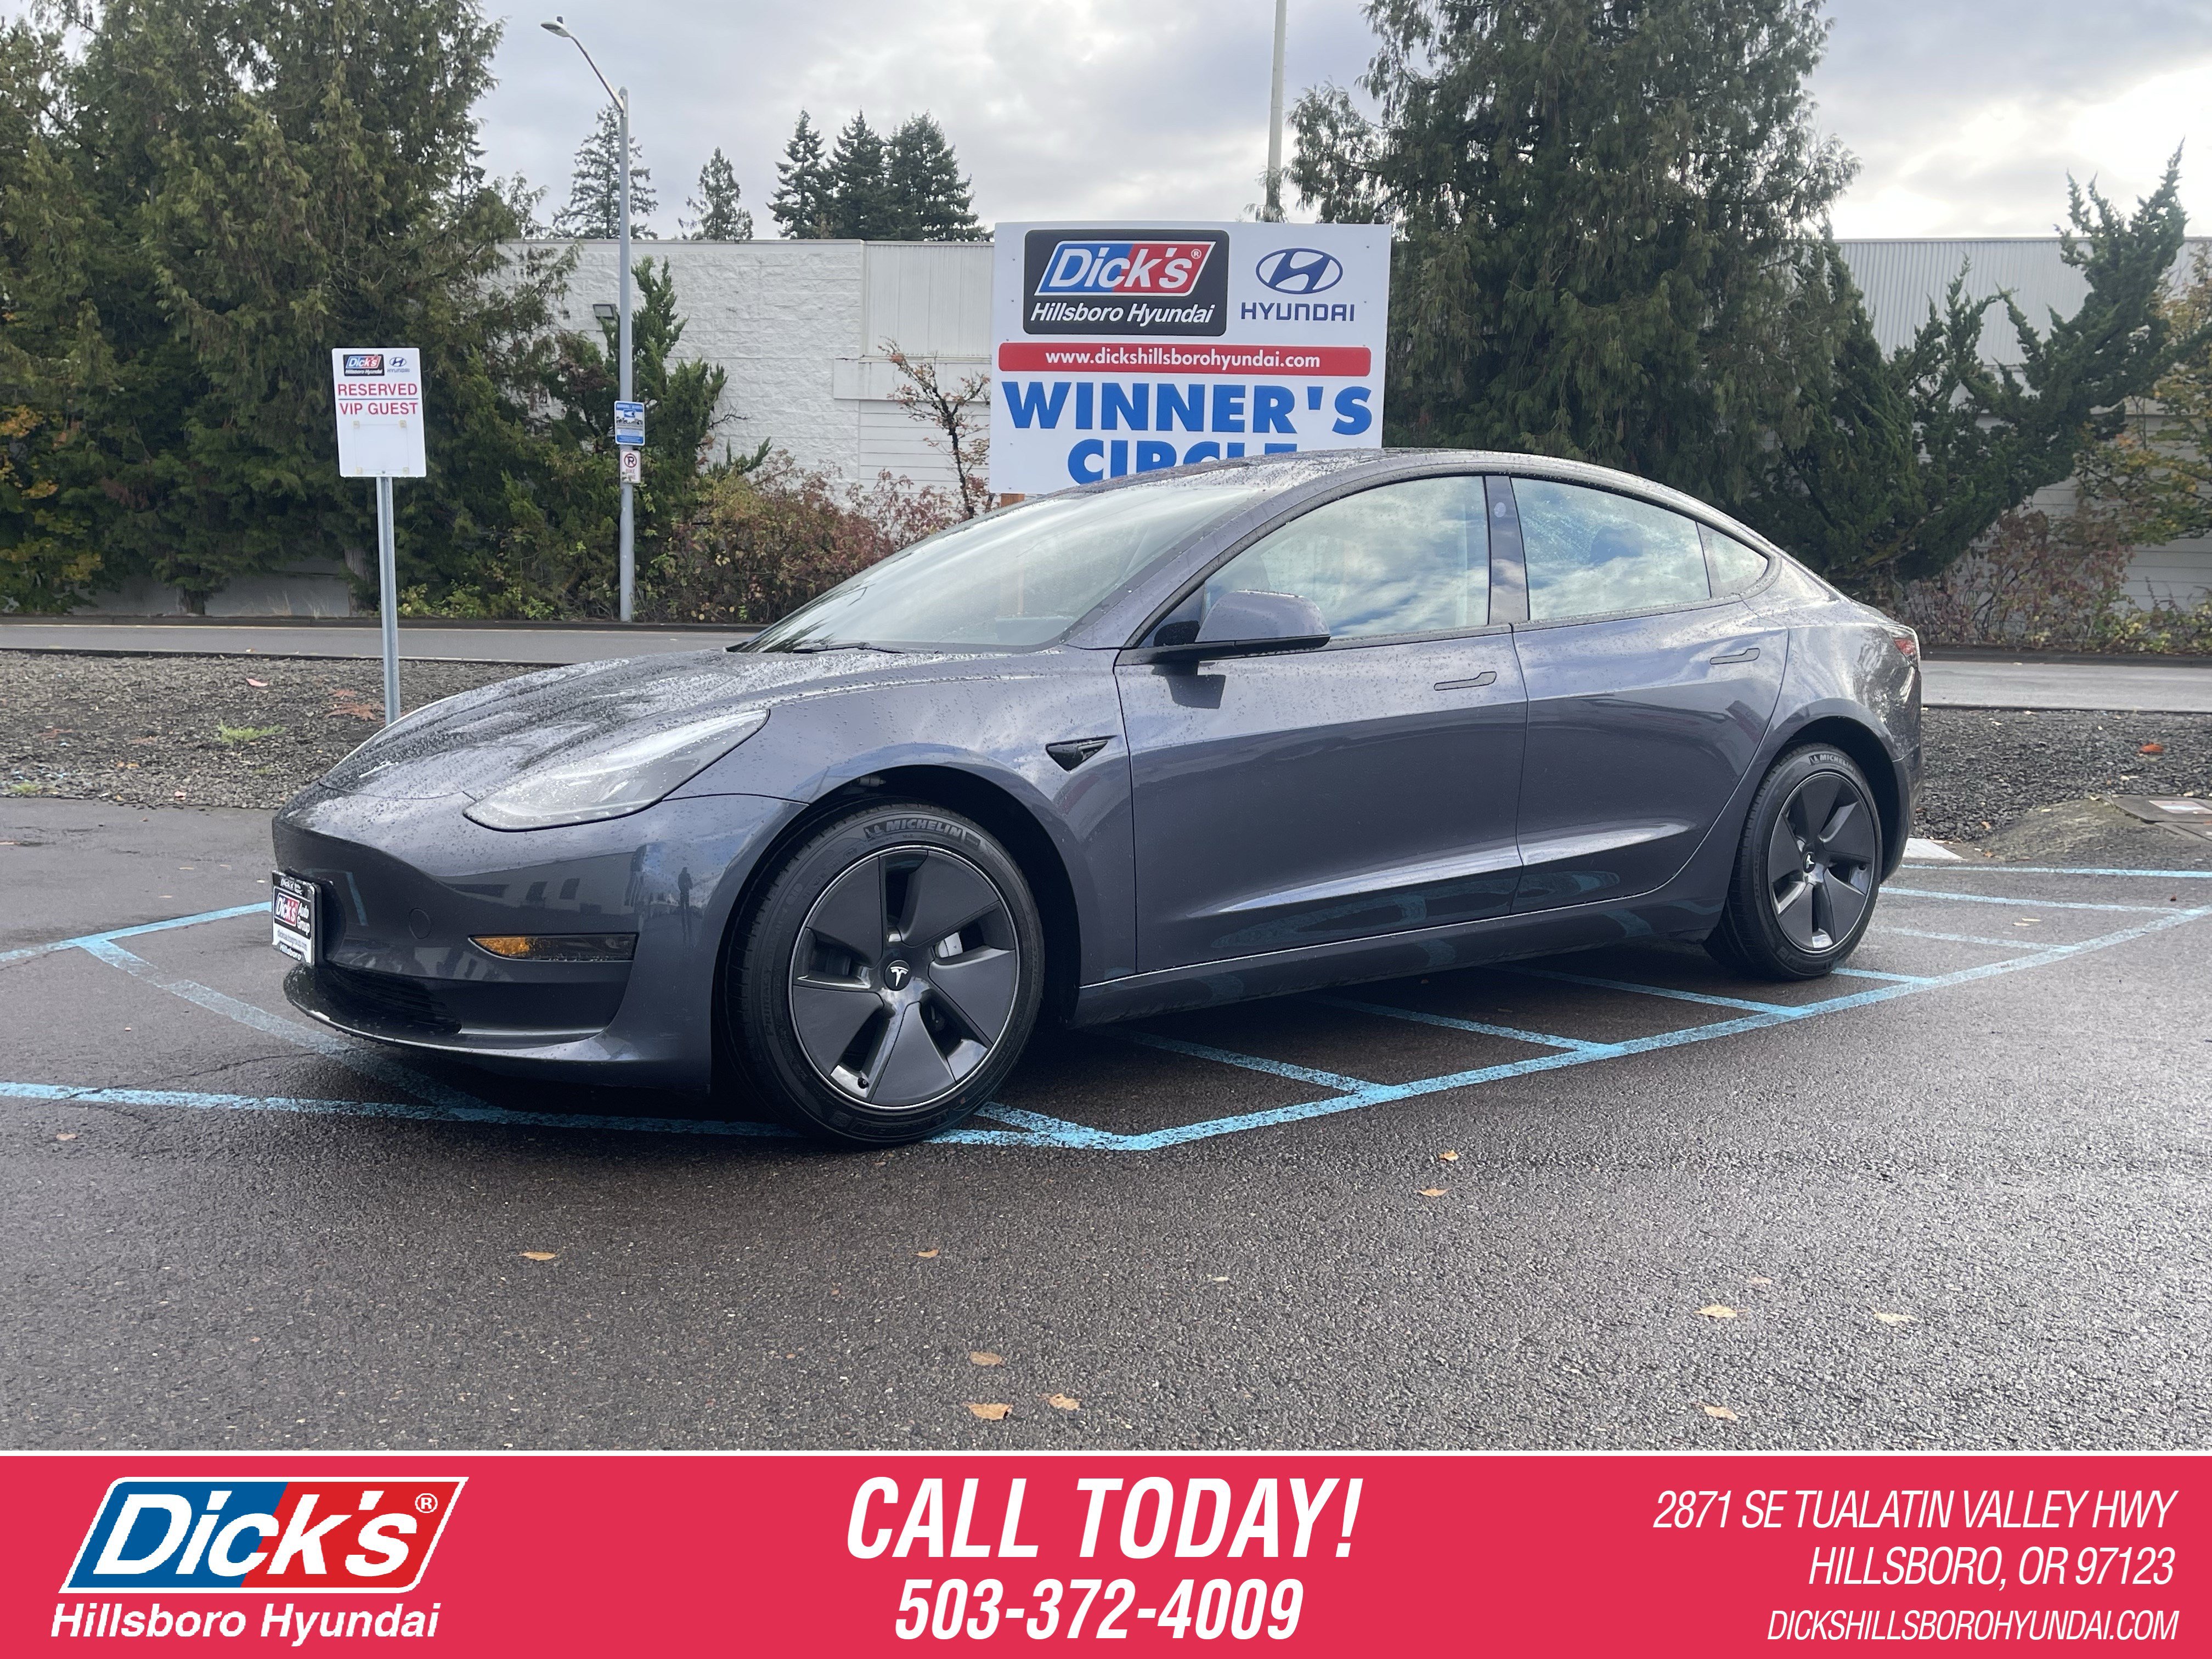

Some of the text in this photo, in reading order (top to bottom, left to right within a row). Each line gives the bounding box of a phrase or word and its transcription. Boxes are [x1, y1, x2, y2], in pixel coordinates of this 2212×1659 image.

[1030, 302, 1216, 328] Hillsboro Hyundai
[1240, 302, 1355, 321] HYUNDAI
[1046, 347, 1321, 371] www.dickshillsborohyundai.com
[337, 383, 417, 396] RESERVED
[340, 402, 418, 415] VIP GUEST
[1002, 381, 1372, 435] WINNER'S
[1068, 438, 1298, 484] CIR
[1819, 753, 1854, 771] MICHELIN
[885, 818, 964, 838] MICHELIN
